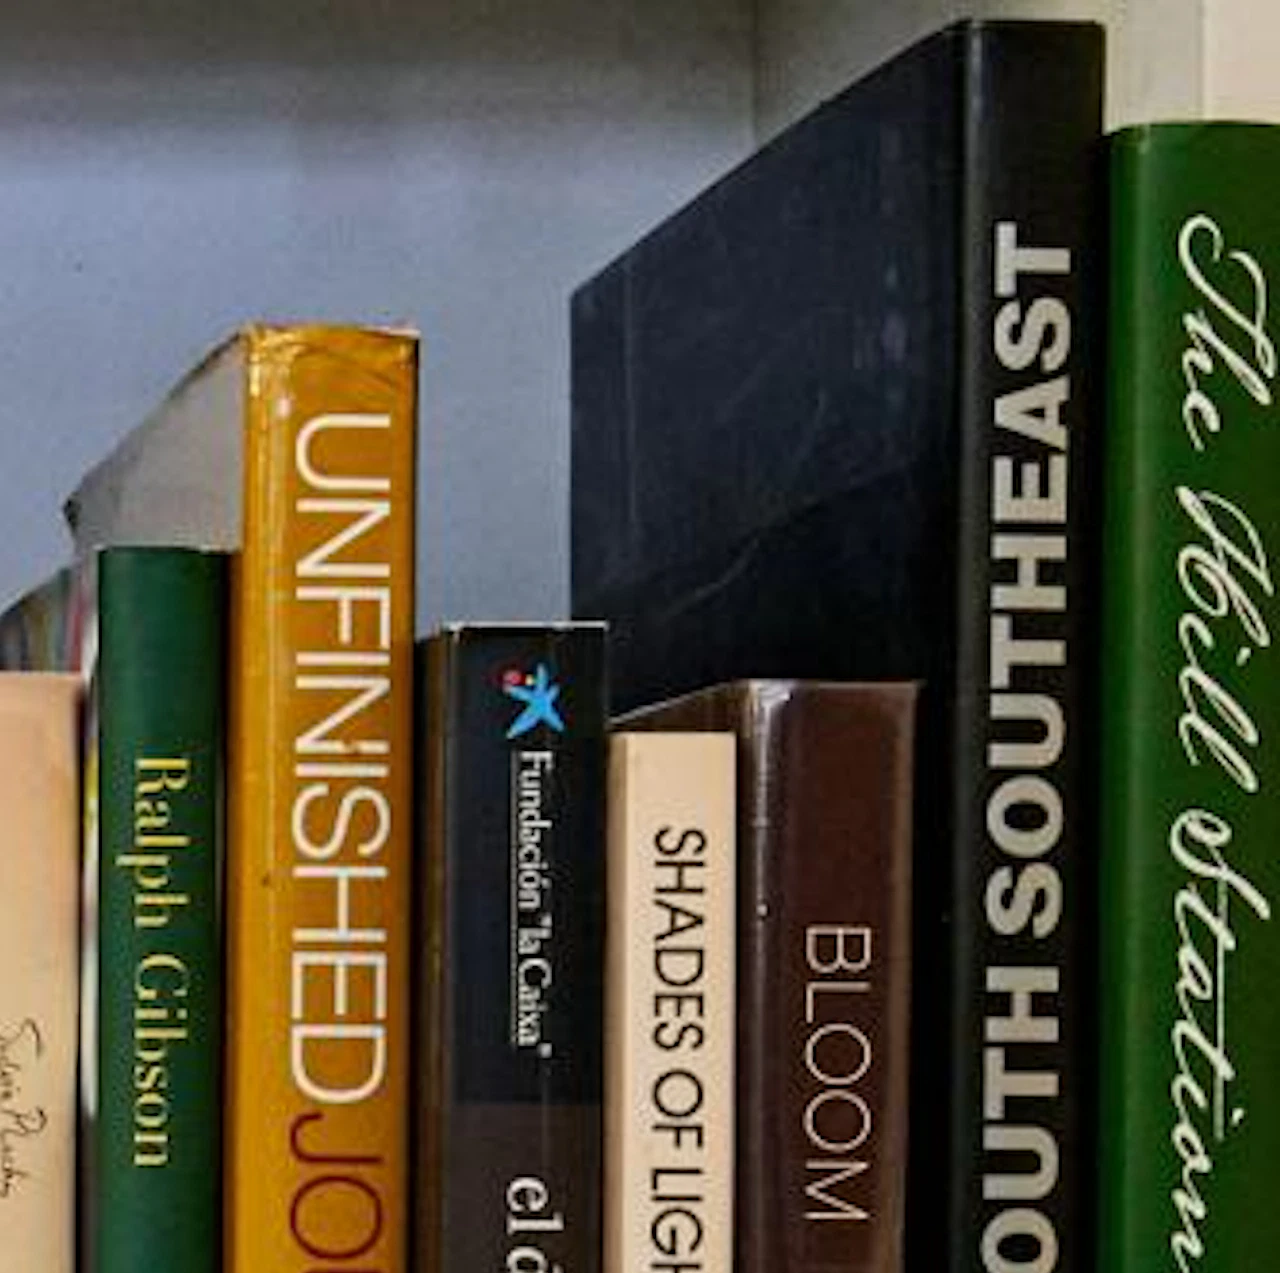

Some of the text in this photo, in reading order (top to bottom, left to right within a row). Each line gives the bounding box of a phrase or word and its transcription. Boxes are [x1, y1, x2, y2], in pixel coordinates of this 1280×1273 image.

[1177, 213, 1279, 453] The
[984, 221, 1074, 940] SOUTHEAST
[1175, 485, 1275, 794] Hill
[287, 412, 395, 1104] UNFINISHED
[515, 750, 555, 911] Fundación
[114, 756, 192, 1170] Ralph Gibson
[651, 826, 708, 1052] SHADES
[504, 1175, 565, 1233] el
[651, 1069, 705, 1149] OF
[802, 925, 874, 1223] BLOOM
